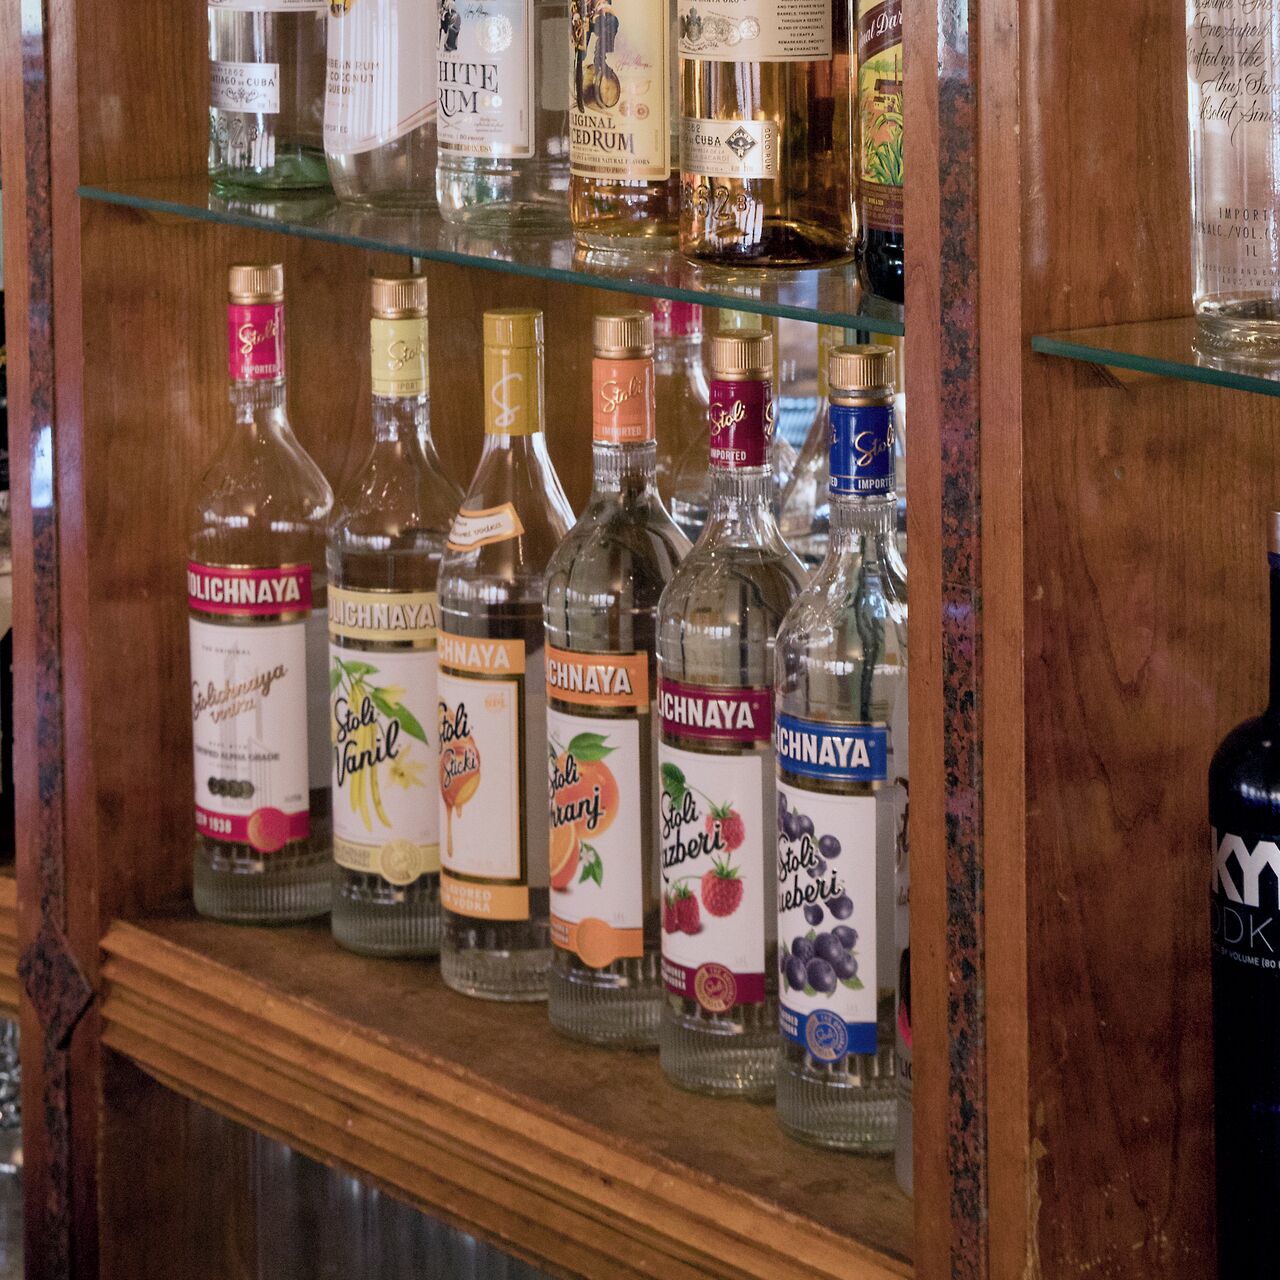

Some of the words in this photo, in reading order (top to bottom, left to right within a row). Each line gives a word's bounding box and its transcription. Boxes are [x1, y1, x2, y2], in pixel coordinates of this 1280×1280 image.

[246, 78, 275, 87] CUBA
[592, 129, 634, 155] RUM
[694, 134, 721, 146] CUBA
[764, 127, 772, 150] GOLD
[1245, 244, 1258, 257] 1L
[600, 376, 643, 414] Stoli
[601, 425, 642, 437] IMPORTED
[711, 400, 746, 436] Stoli
[334, 696, 378, 743] Stoli
[248, 752, 280, 762] GRADE
[334, 719, 400, 787] Vanil
[444, 748, 477, 788] Sticki
[661, 790, 699, 839] Stoli
[778, 832, 816, 883] Stoli
[1261, 957, 1276, 970] (80
